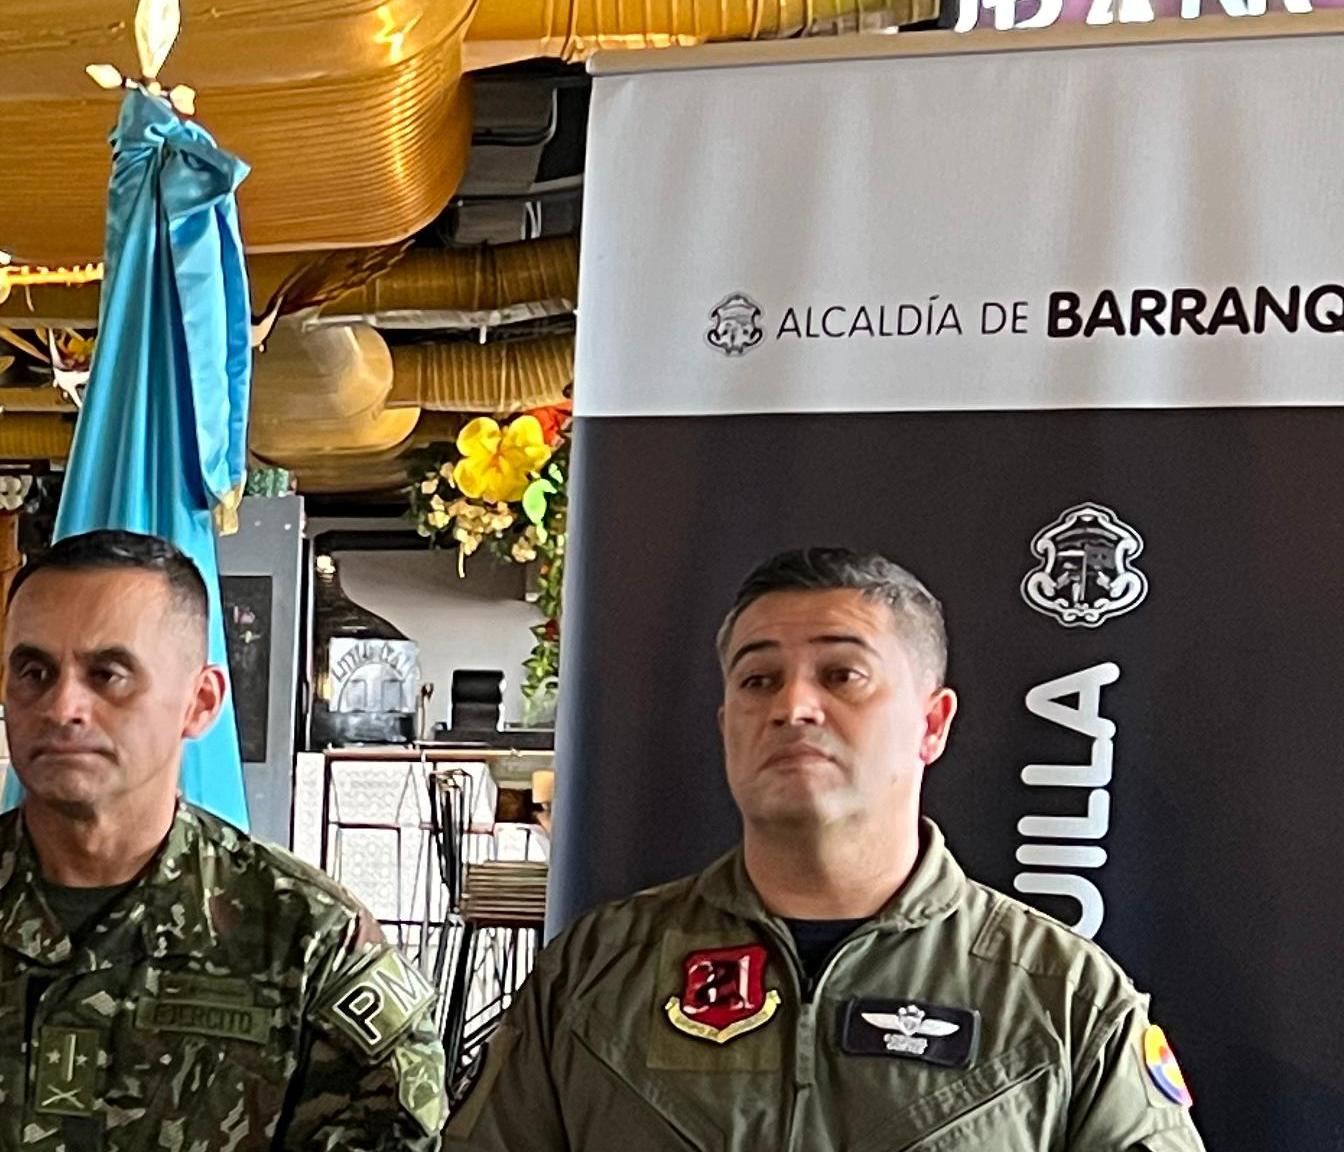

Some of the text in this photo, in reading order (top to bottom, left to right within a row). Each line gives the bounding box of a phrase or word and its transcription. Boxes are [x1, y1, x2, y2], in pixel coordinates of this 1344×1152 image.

[775, 294, 963, 339] ALCALDÍA
[980, 301, 1029, 335] DE
[332, 950, 435, 1046] PM
